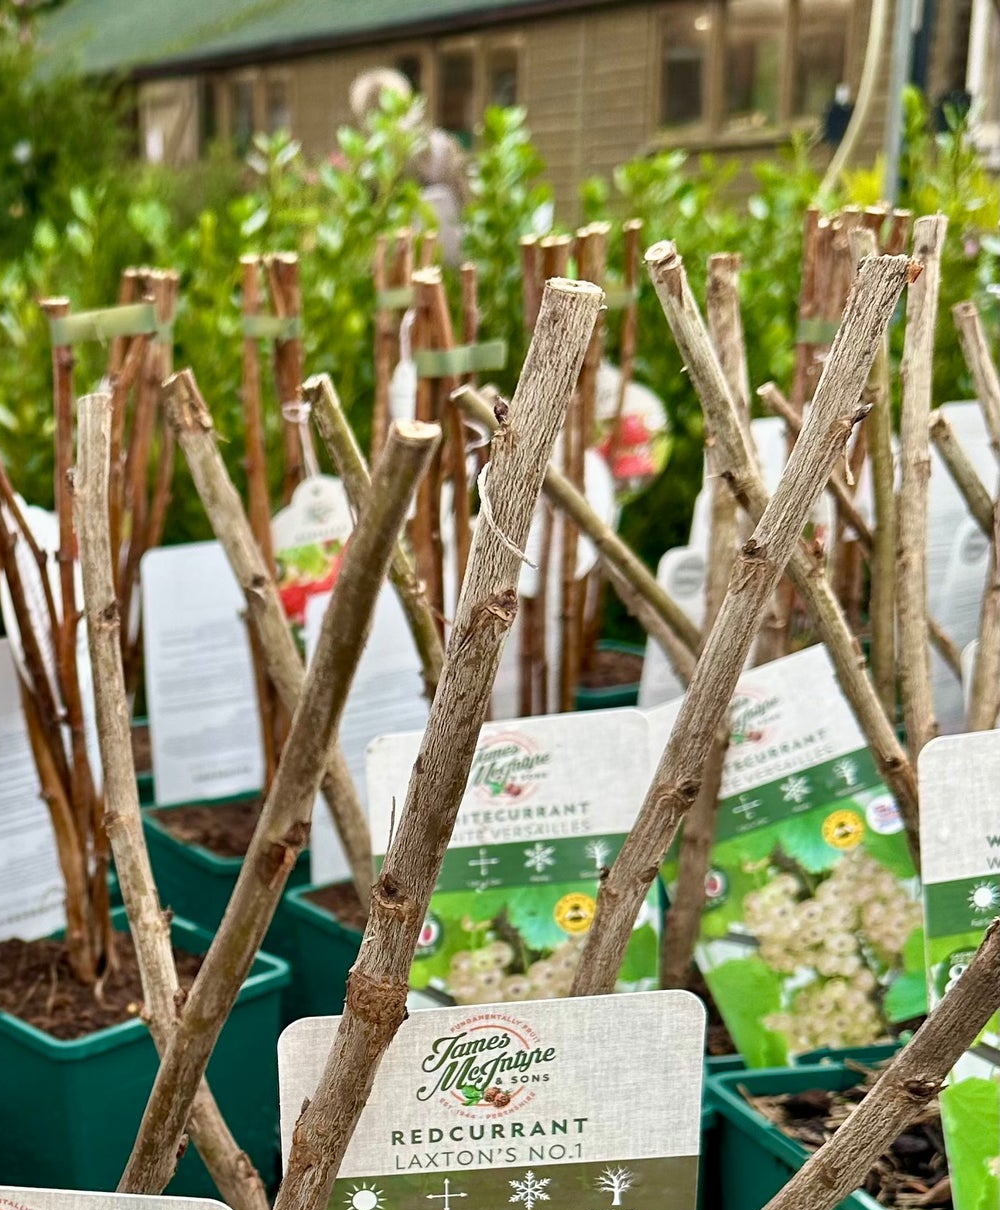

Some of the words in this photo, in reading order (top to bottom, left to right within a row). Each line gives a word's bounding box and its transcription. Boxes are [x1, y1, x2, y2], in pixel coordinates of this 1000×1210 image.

[456, 802, 590, 825] ITECURRANT
[450, 1014, 521, 1032] FUNDAMENTALLY
[422, 1032, 511, 1072] James
[416, 1047, 556, 1101] McIntyre
[511, 1074, 550, 1084] SONS
[391, 1118, 588, 1145] REDCURRANT
[395, 1147, 517, 1169] LAXTON'S
[529, 1143, 581, 1161] NO.1
